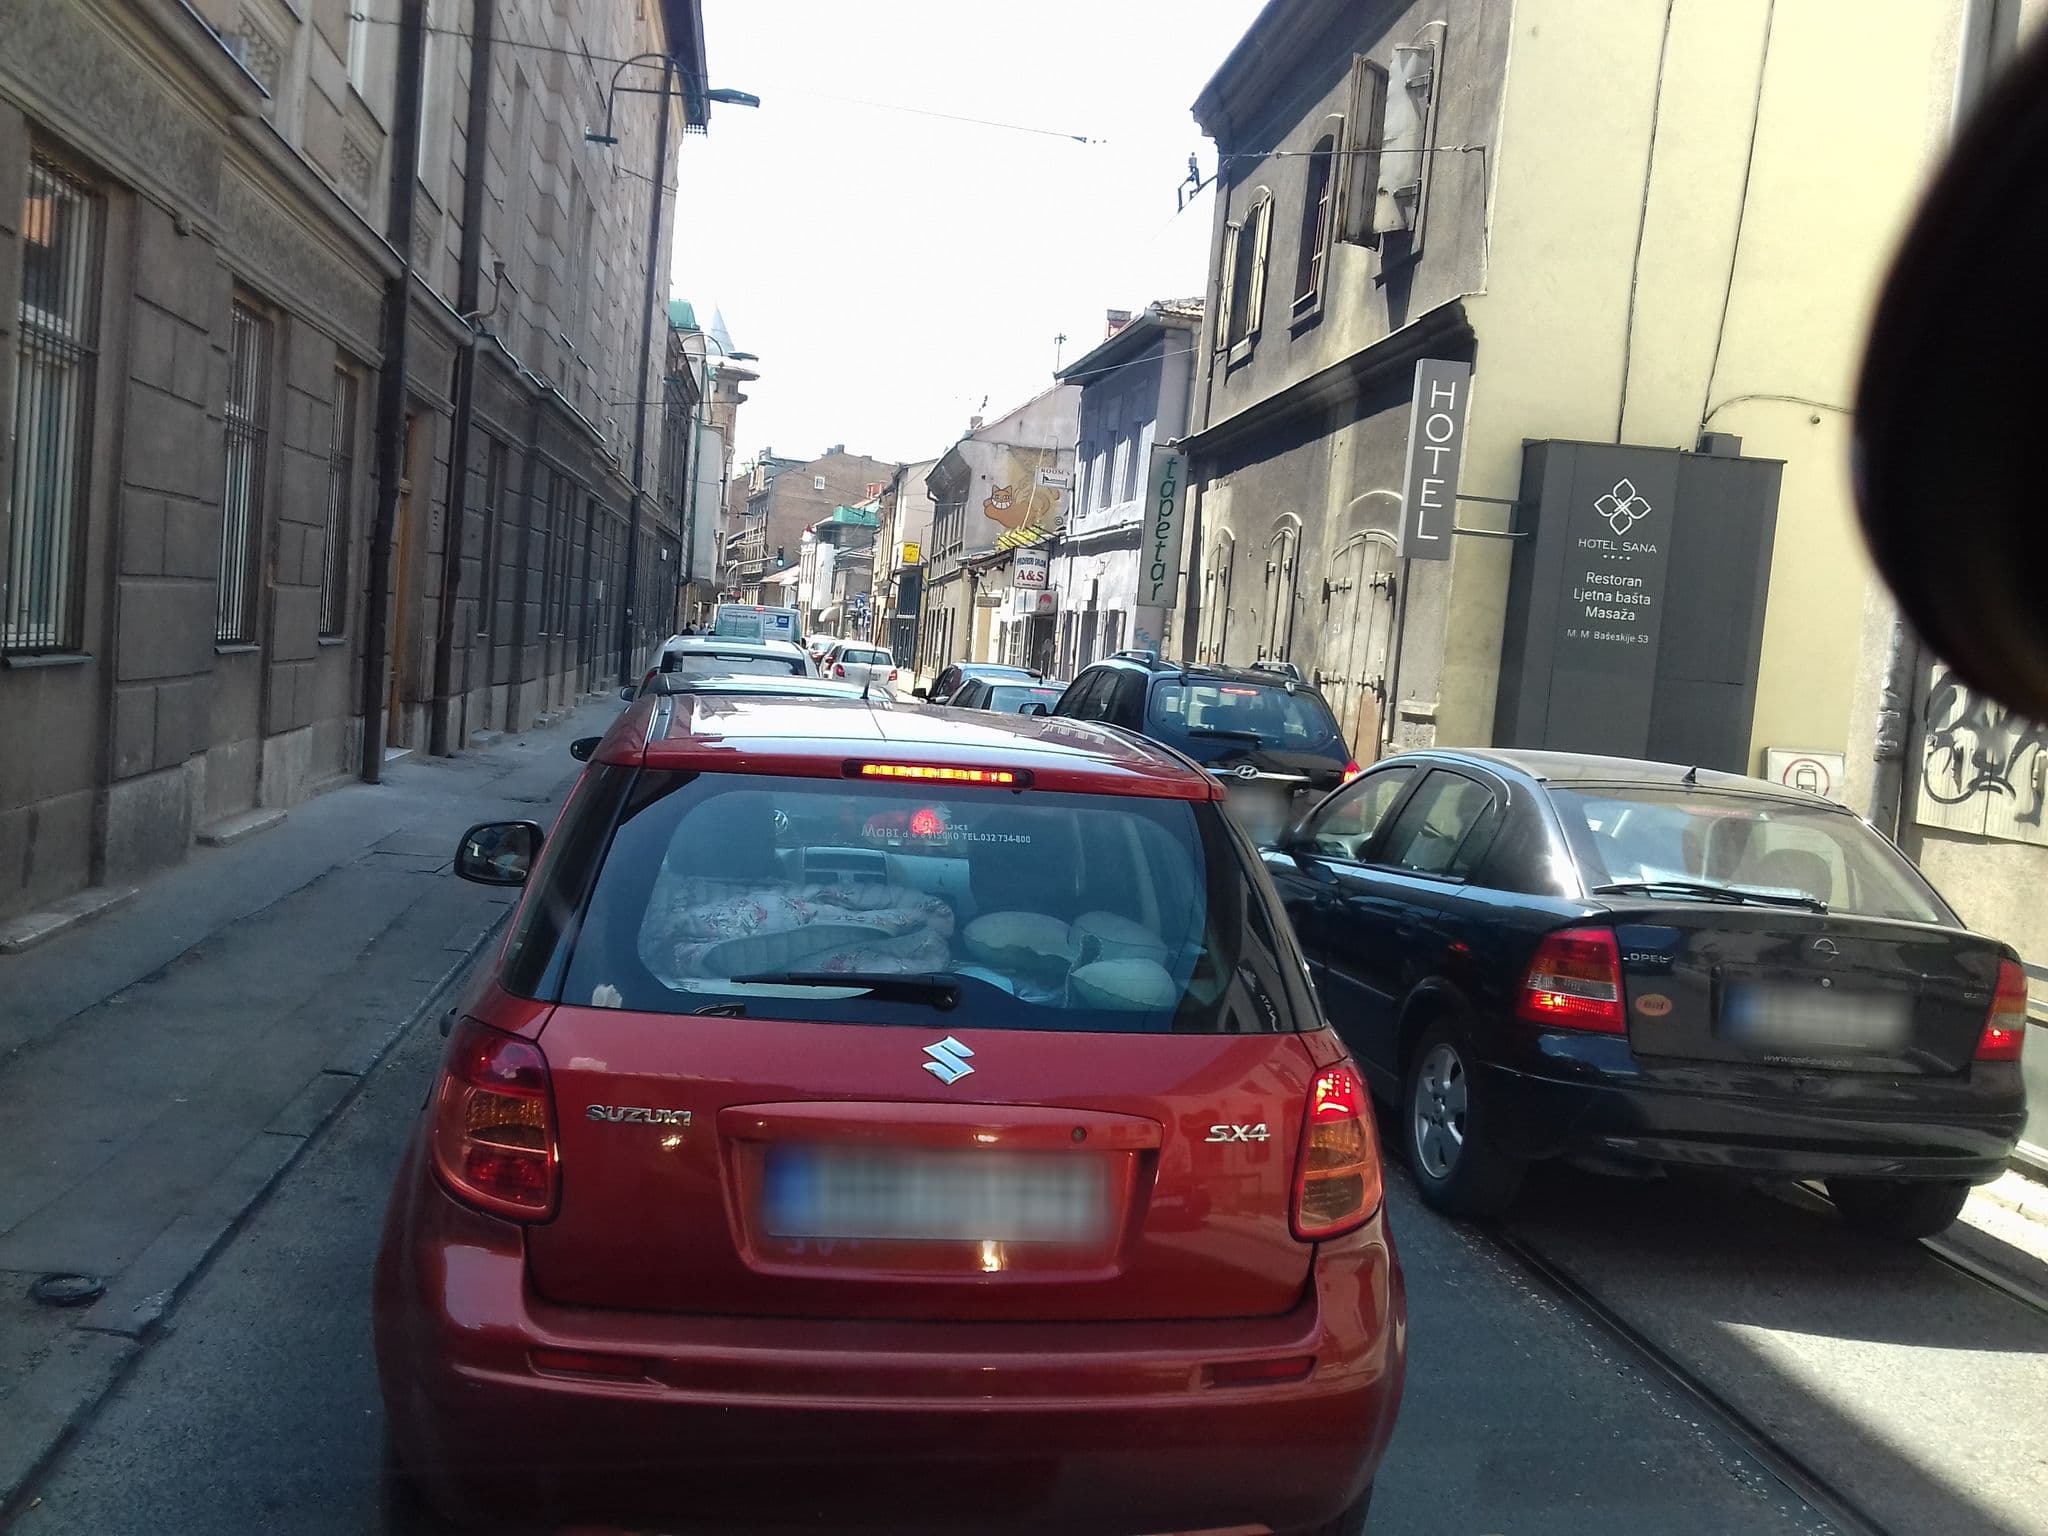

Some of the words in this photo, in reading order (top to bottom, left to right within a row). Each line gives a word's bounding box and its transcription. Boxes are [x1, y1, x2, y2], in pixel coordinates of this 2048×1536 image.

[1417, 380, 1456, 540] HOTEL
[1150, 456, 1177, 601] tapetar
[1578, 538, 1618, 550] HOTEL
[1622, 541, 1657, 553] SANA
[1016, 569, 1045, 582] A&S
[1586, 571, 1642, 587] Restoran
[1573, 587, 1613, 602] Ljetna
[1615, 590, 1651, 605] bašta
[1585, 606, 1635, 621] Masaža
[1593, 631, 1635, 644] Bašeskije
[1637, 634, 1649, 644] 53
[862, 823, 899, 838] MOBI
[1630, 953, 1668, 964] OPEL
[586, 1104, 692, 1127] SUZUKI
[1204, 1123, 1271, 1142] SX4
